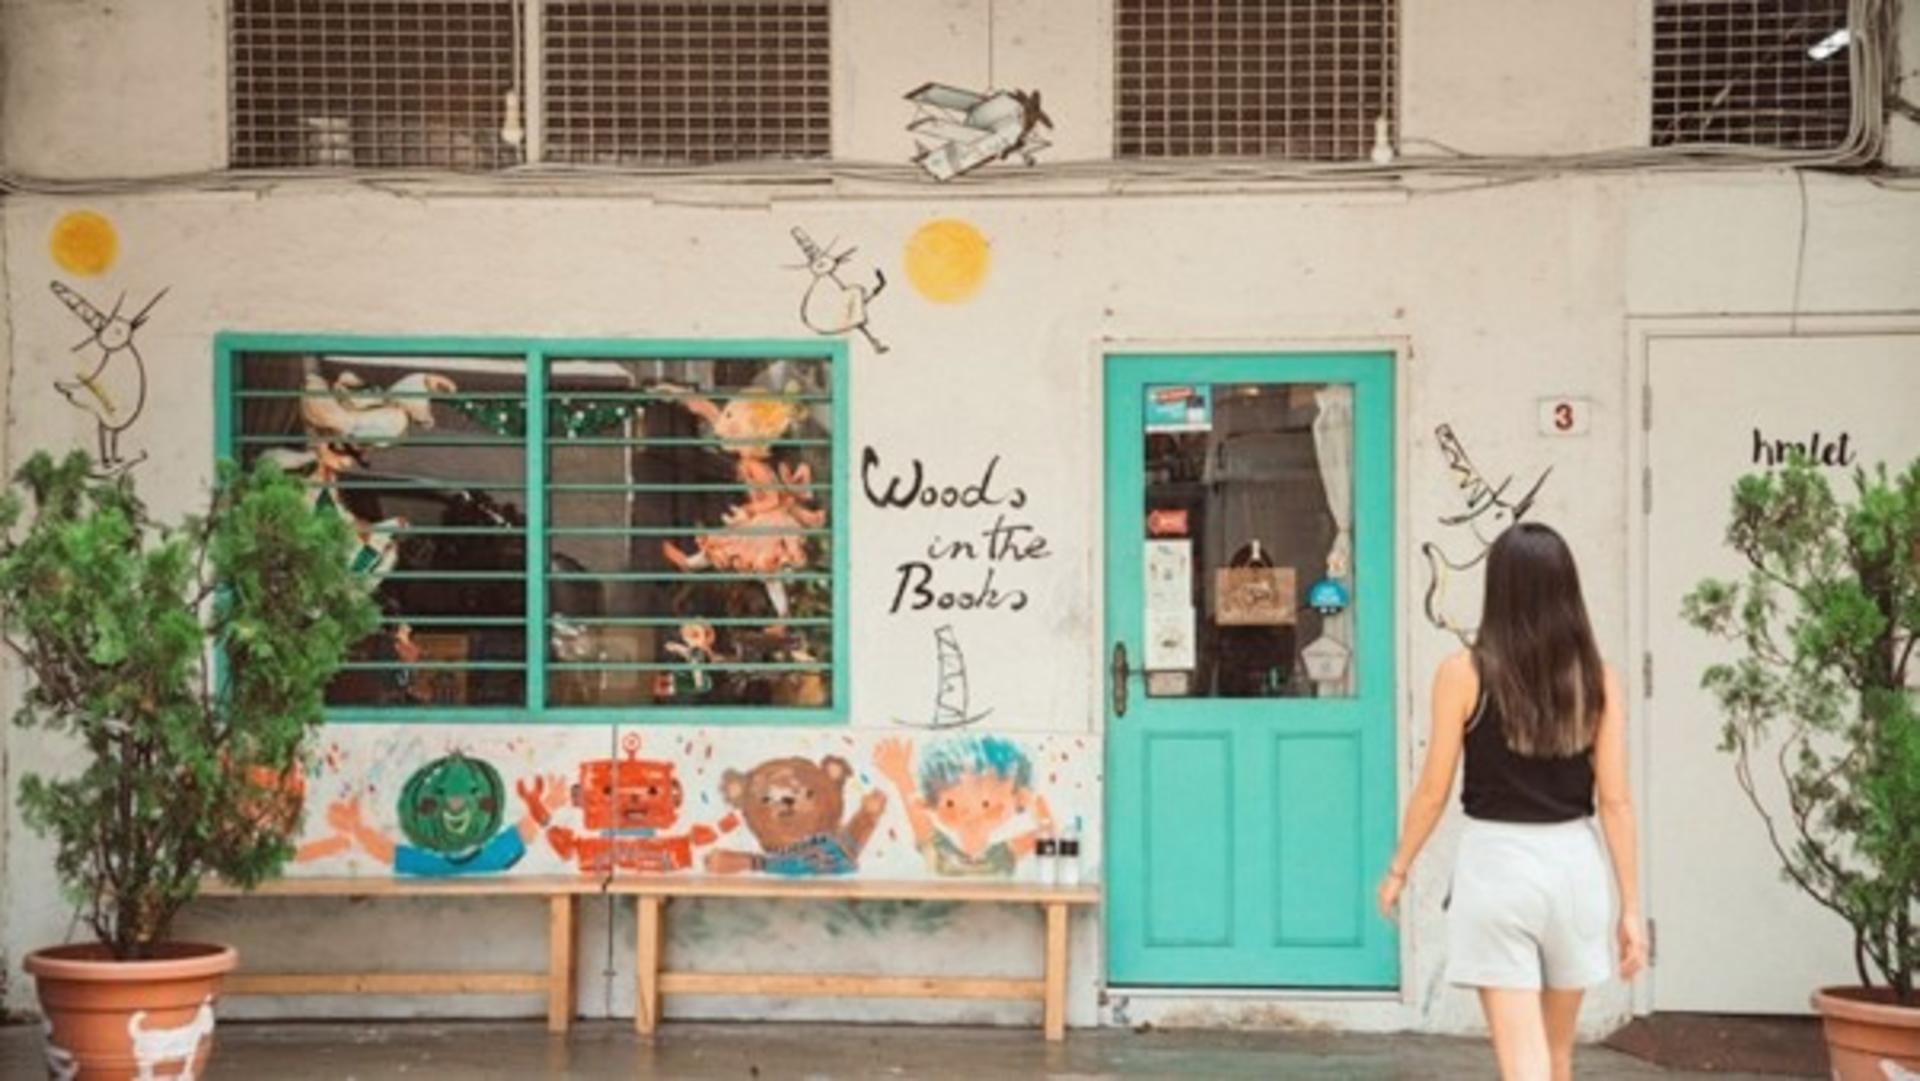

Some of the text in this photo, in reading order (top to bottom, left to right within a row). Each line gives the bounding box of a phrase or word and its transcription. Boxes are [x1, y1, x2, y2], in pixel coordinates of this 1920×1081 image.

[1554, 404, 1574, 431] 3
[861, 445, 1028, 509] Woods
[888, 561, 1029, 615] Books
